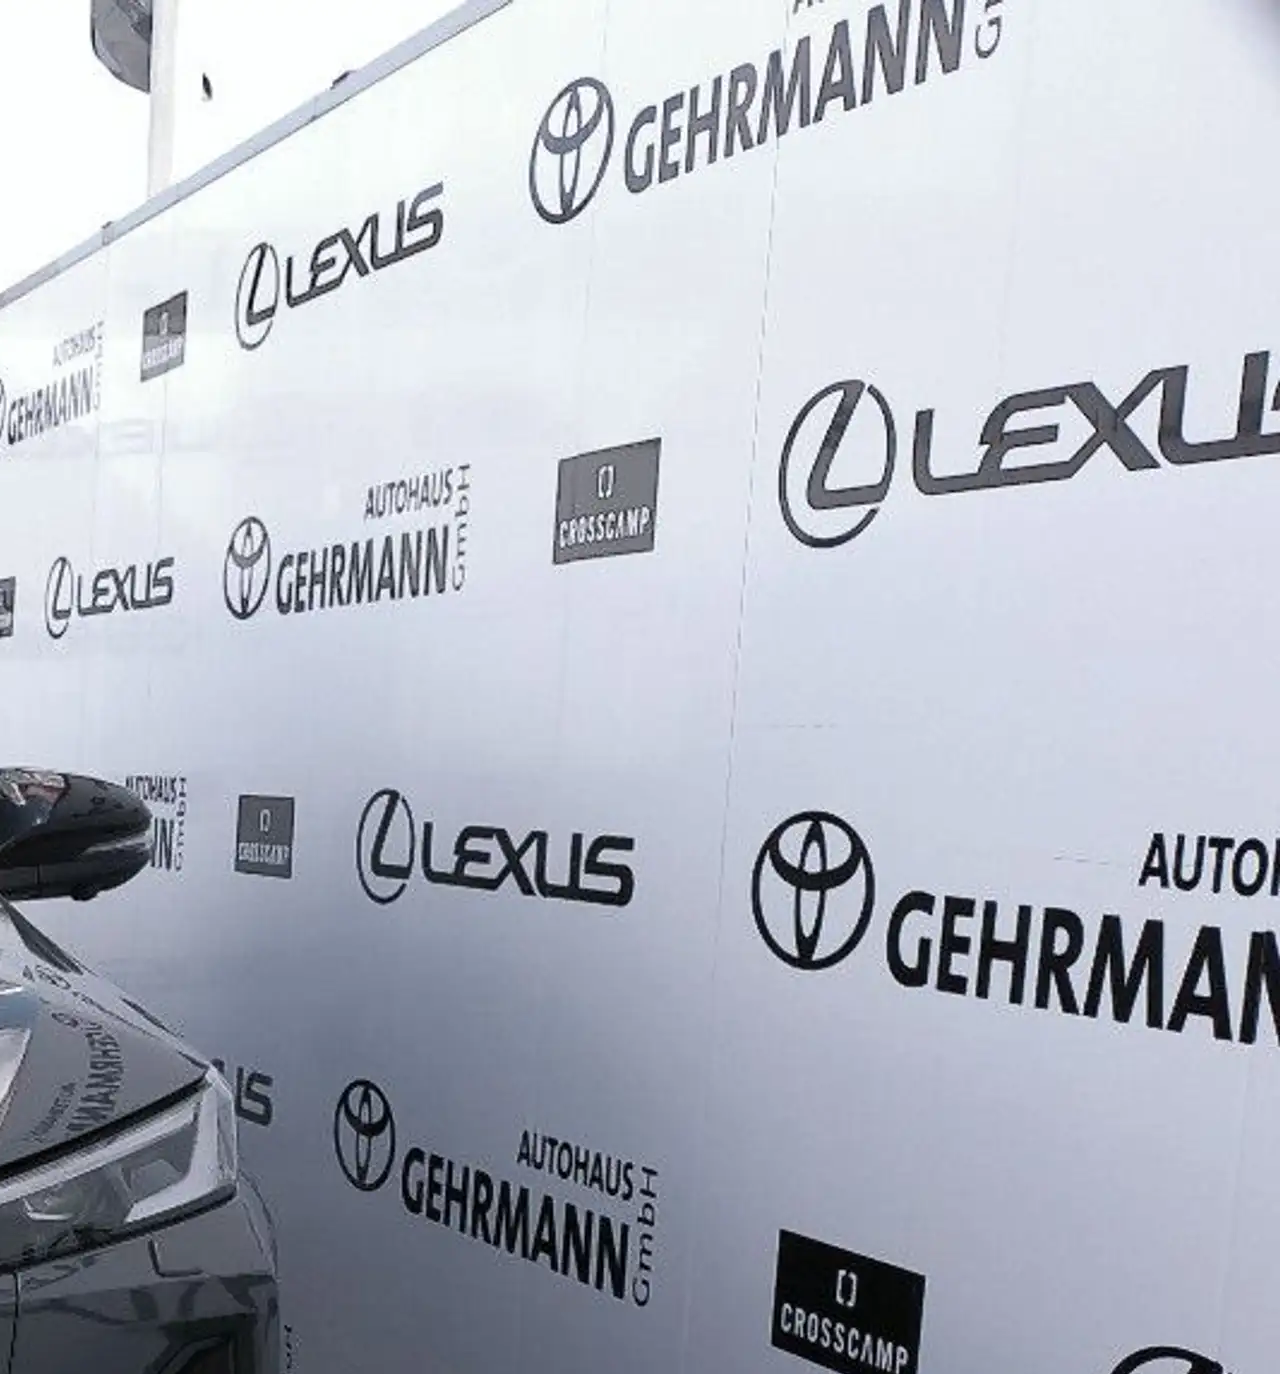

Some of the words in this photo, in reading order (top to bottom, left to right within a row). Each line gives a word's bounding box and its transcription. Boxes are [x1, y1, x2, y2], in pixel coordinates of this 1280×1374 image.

[624, 0, 965, 193] GEHRMANN
[285, 182, 443, 308] LEXUS
[8, 365, 93, 445] GEHRMANN
[912, 351, 1280, 495] LEXU
[364, 468, 453, 520] AUTOHAUS
[451, 464, 470, 591] GmbH
[560, 506, 649, 548] CROSSCAMP
[74, 557, 174, 617] LEXUS
[276, 525, 448, 615] GEHRMANN
[422, 822, 634, 907] LEXUS
[517, 1130, 633, 1201] AUTOHAUS
[402, 1149, 628, 1299] GEHRMANN
[631, 1165, 658, 1306] GmbH
